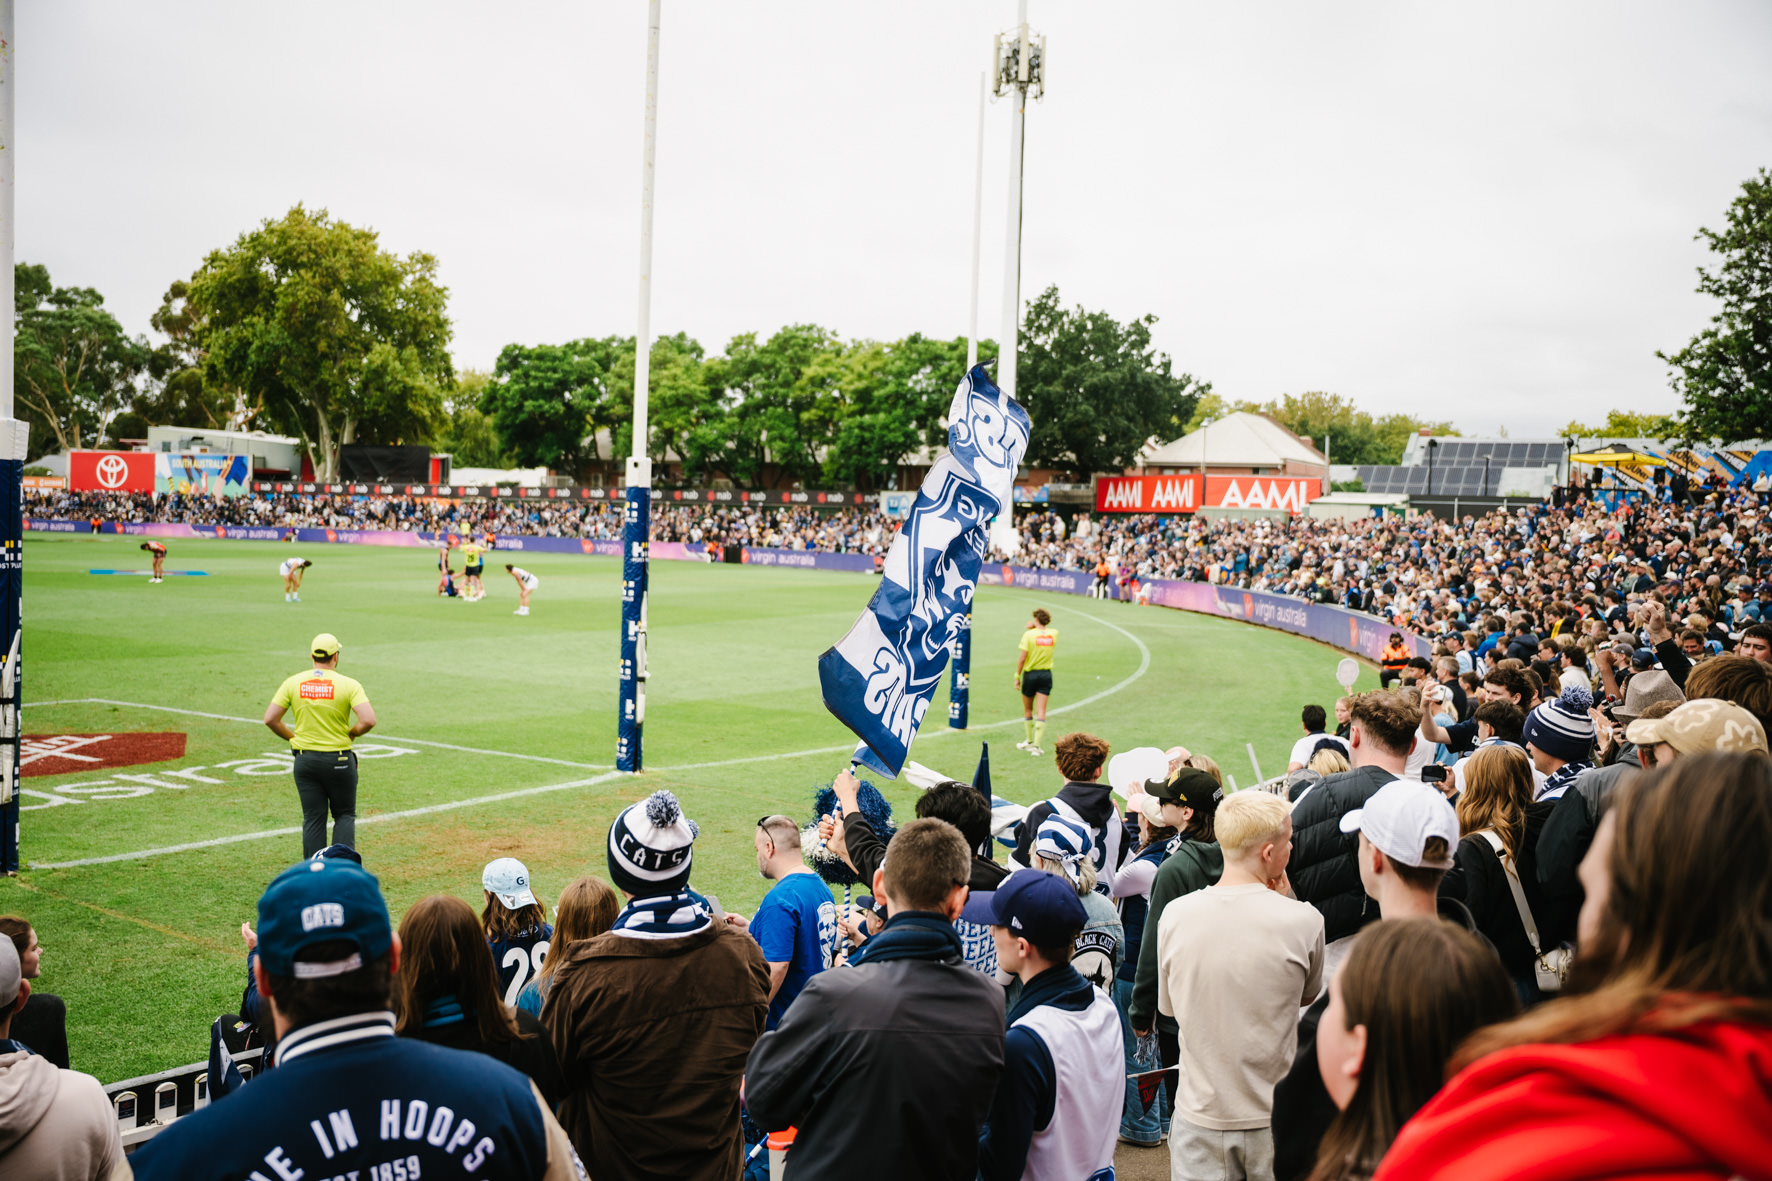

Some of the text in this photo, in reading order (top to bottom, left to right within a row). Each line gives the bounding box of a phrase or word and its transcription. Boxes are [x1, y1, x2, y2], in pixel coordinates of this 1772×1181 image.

[172, 459, 231, 469] SOUTH AUSTRALIA
[499, 487, 512, 496] nab
[528, 487, 540, 496] nab
[557, 487, 570, 497] nab
[590, 488, 604, 498] nab
[683, 490, 699, 499] nab
[716, 490, 732, 500] nab
[750, 491, 766, 502] nab
[1104, 479, 1194, 508] AAMI AAMI
[1220, 478, 1307, 512] AAMI
[791, 492, 808, 503] nab
[827, 492, 844, 503] nab
[31, 521, 75, 531] virgin australia
[227, 529, 278, 539] virgin australia
[496, 538, 523, 549] stralia
[597, 542, 621, 553] virgin
[751, 552, 815, 566] virgin australia
[1015, 572, 1075, 589] virgin australia
[1253, 599, 1307, 627] virgin australia
[301, 685, 333, 693] CHEMIST
[620, 833, 683, 869] CATS
[301, 902, 345, 932] CATS
[1075, 934, 1097, 948] BLACK
[310, 1108, 359, 1159] IN
[380, 1099, 495, 1173] HOOPS
[370, 1155, 421, 1181] 1859
